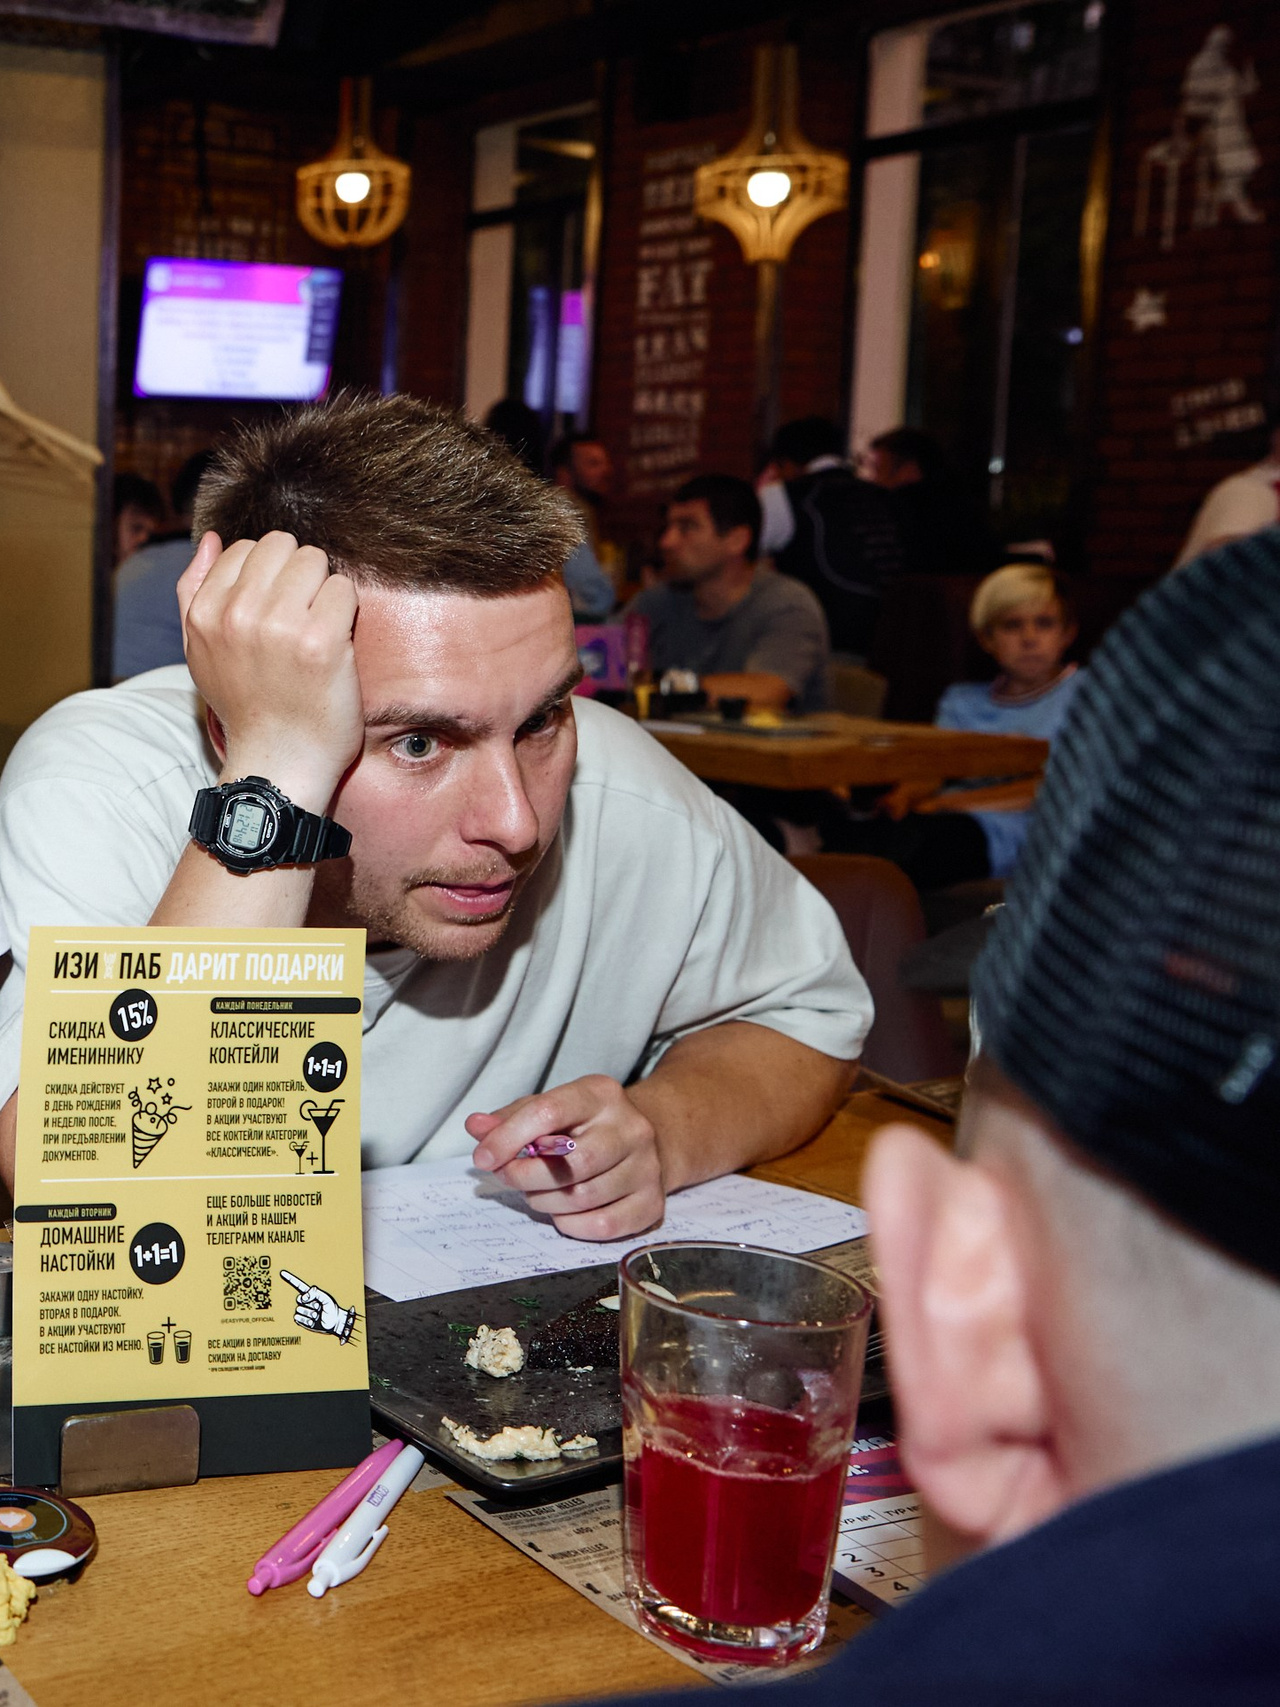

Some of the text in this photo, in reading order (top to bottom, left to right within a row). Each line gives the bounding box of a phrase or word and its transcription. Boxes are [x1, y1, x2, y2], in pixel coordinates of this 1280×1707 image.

[53, 952, 344, 984] ИЗИ ПАБ ДАРИТ ПОДАРКИ
[216, 1000, 293, 1011] КАЖДЫЙ ПОНЕДЕЛЬНИК
[118, 999, 153, 1032] 15%
[49, 1022, 105, 1040] СКИДКА
[211, 1022, 315, 1038] КЛАССИЧЕСКИЕ
[48, 1048, 144, 1065] ИМЕНИННИКУ
[210, 1045, 279, 1064] КОКТЕЙЛИ
[307, 1057, 343, 1079] 1+1=1
[45, 1081, 125, 1096] СКИДКА ДЕЙСТВУЕТ
[207, 1081, 240, 1093] ЗАКАЖИ
[242, 1081, 264, 1093] ОДИН
[44, 1099, 121, 1112] В ДЕНЬ РОЖДЕНИЯ
[207, 1096, 286, 1110] ВТОРОЙ В ПОДАРОК!
[43, 1117, 50, 1128] И
[51, 1116, 87, 1129] НЕДЕЛЮ
[206, 1113, 288, 1126] В АКЦИИ УЧАСТВУЮТ
[42, 1132, 126, 1145] ПРИ ПРЕДЪЯВЛЕНИИ
[206, 1129, 308, 1142] ВСЕ КОКТЕЙЛИ КАТЕГОРИИ
[41, 1150, 100, 1163] ДОКУМЕНТОВ.
[206, 1146, 279, 1158] «КЛАССИЧЕСКИЕ».
[207, 1192, 322, 1209] ЕЩЕ БОЛЬШЕ НОВОСТЕЙ
[48, 1208, 112, 1218] КАЖДЫЙ ВТОРНИК
[207, 1212, 297, 1227] И АКЦИЙ В НАШЕМ
[40, 1226, 125, 1247] ДОМАШНИЕ
[207, 1231, 305, 1245] ТЕЛЕГРАММ КАНАЛЕ
[134, 1241, 178, 1267] 1+1=1
[40, 1251, 115, 1272] НАСТОЙКИ
[40, 1291, 75, 1303] ЗАКАЖИ
[77, 1290, 100, 1302] ОДНУ
[40, 1308, 70, 1320] ВТОРАЯ
[73, 1308, 78, 1319] В
[40, 1323, 125, 1337] В АКЦИИ УЧАСТВУЮТ
[40, 1340, 144, 1354] ВСЕ НАСТОЙКИ ИЗ МЕНЮ.
[208, 1336, 302, 1349] ВСЕ АКЦИИ В ПРИЛОЖЕНИИ!
[208, 1351, 282, 1363] СКИДКИ НА ДОСТАВКУ
[841, 1552, 863, 1564] 2
[864, 1566, 886, 1578] 3
